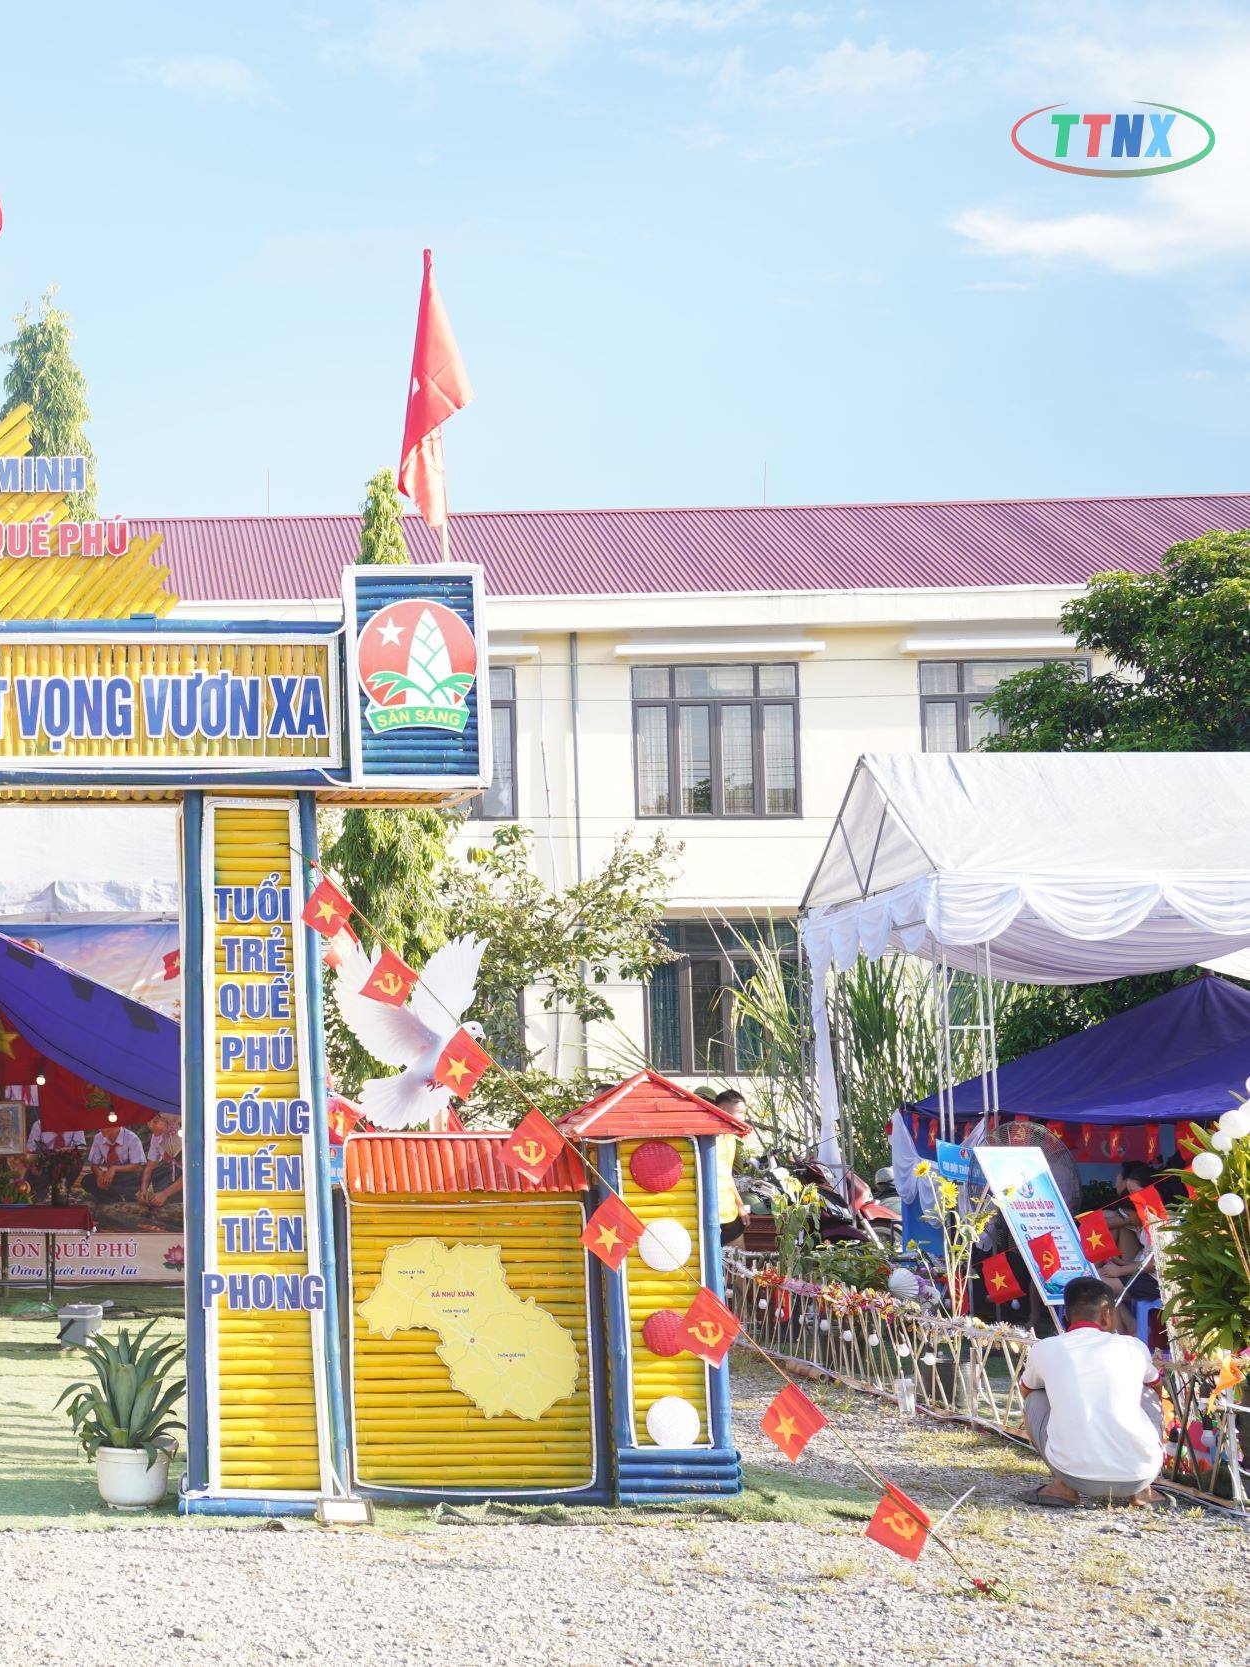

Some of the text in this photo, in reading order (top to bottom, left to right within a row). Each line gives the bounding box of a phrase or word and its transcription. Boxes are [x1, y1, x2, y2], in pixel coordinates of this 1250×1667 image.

[59, 515, 129, 557] PHÚ
[14, 677, 133, 752] VỌNG
[141, 671, 259, 740] VƯƠN
[267, 676, 330, 738] XA
[414, 707, 461, 727] SÀNG
[214, 873, 292, 923] TUỔI
[221, 926, 287, 974] TRẺ
[218, 972, 294, 1022] QUẾ
[220, 1028, 295, 1071] PHÚ
[216, 1087, 311, 1136] CỐNG
[216, 1144, 302, 1191] HIẾN
[96, 1238, 137, 1258] PHÚ
[220, 1209, 304, 1252] TIÊN
[121, 1265, 138, 1276] lai
[202, 1272, 326, 1312] PHONG
